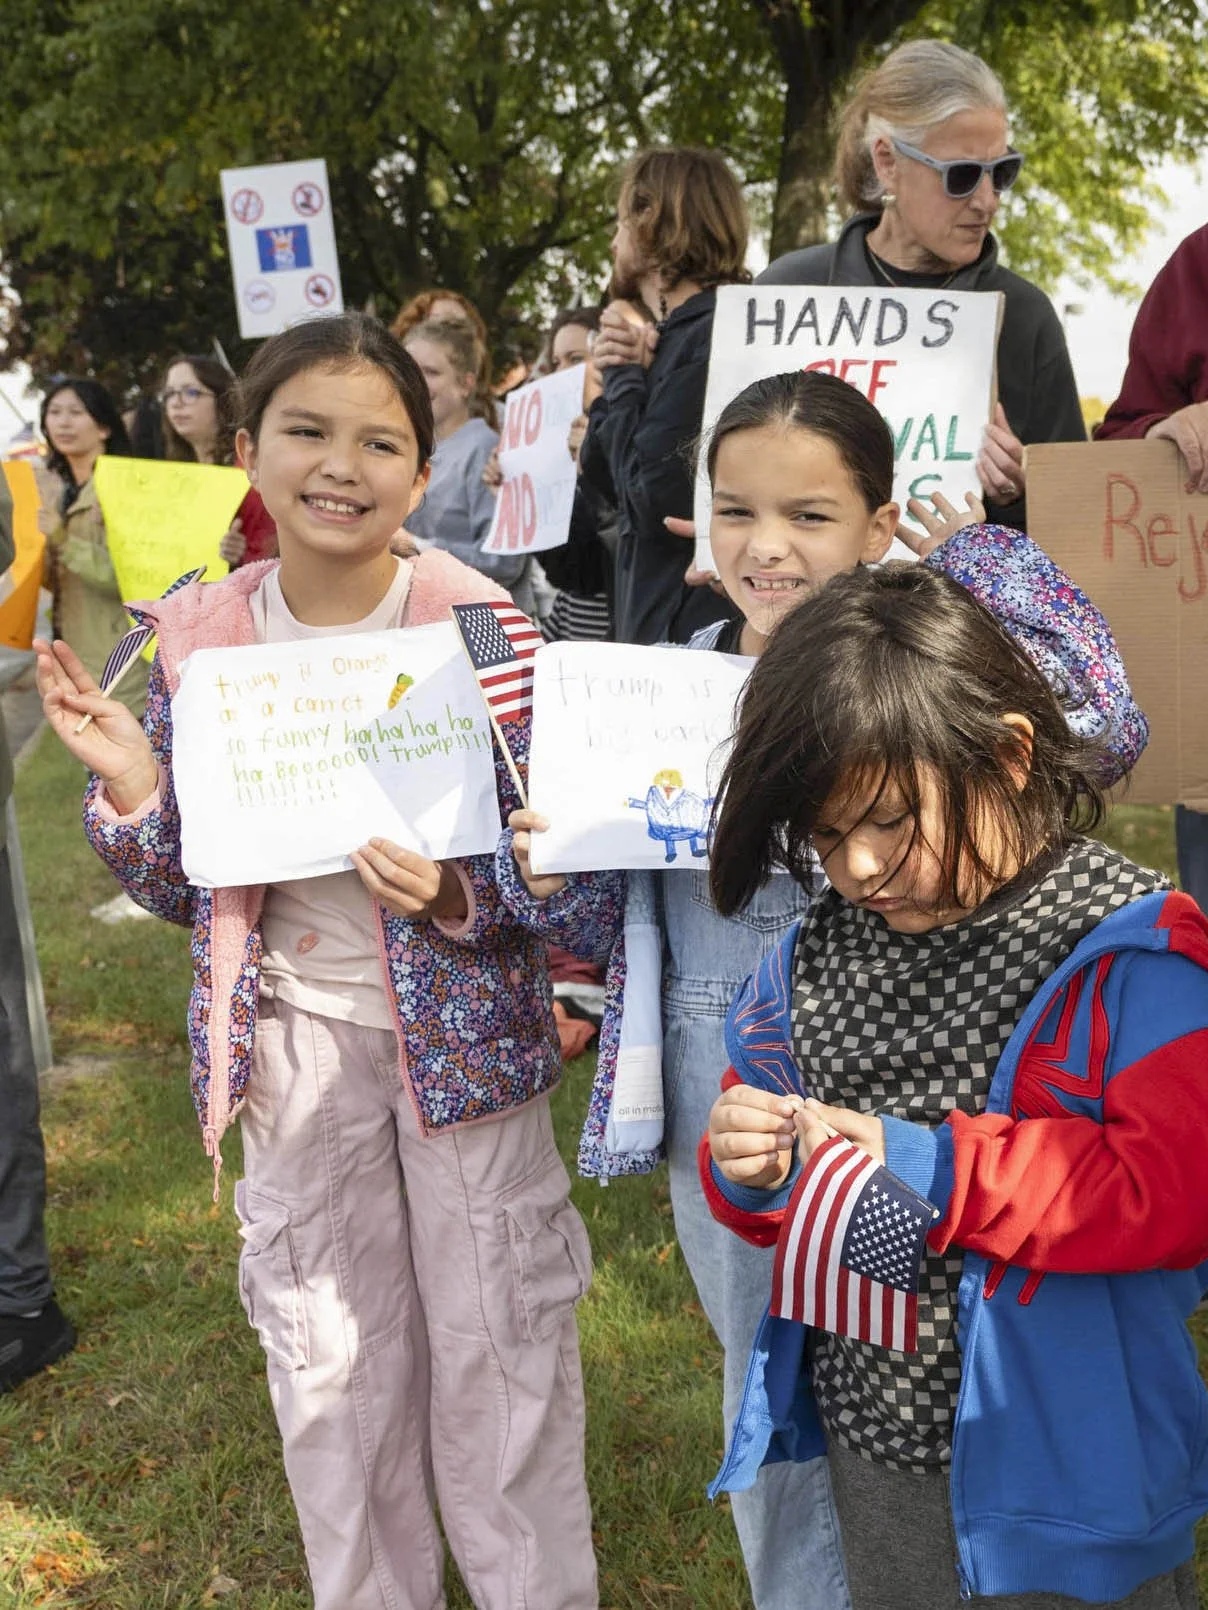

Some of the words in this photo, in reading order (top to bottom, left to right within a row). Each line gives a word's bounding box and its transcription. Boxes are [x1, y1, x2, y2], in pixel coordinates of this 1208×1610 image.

[745, 296, 960, 348] HANDS
[498, 388, 543, 452] NO
[490, 471, 538, 551] NO
